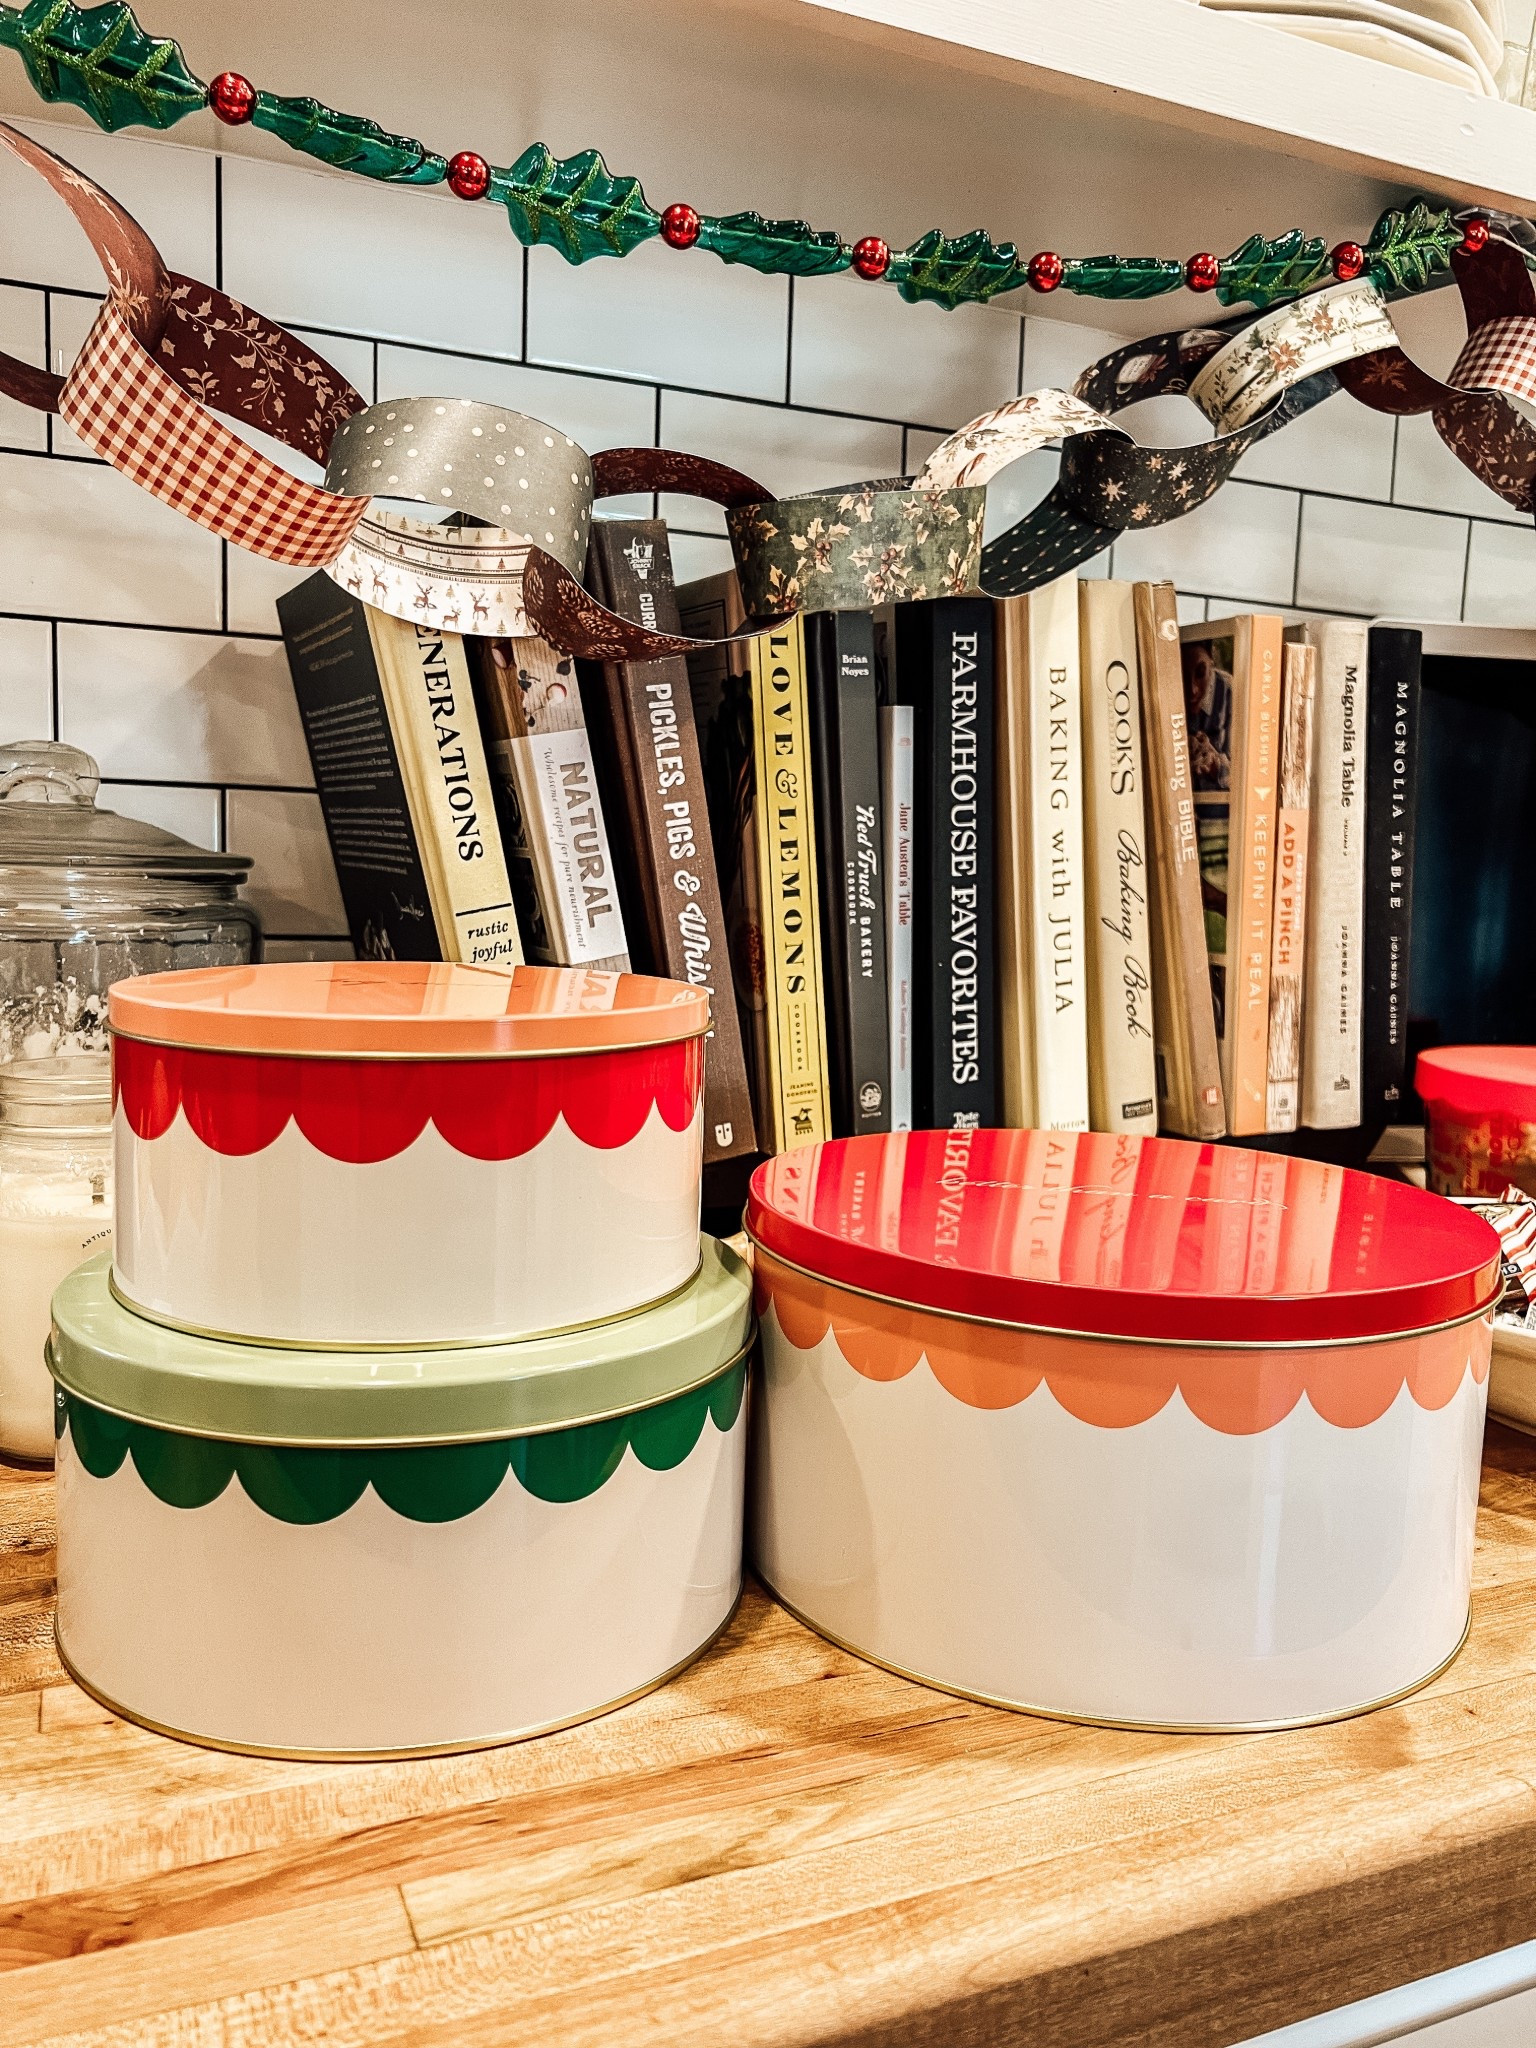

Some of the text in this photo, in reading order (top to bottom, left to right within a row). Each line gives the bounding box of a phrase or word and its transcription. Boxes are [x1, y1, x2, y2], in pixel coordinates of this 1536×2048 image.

[638, 593, 659, 633] CURR
[841, 655, 869, 665] Brian
[841, 666, 870, 677] Noyes
[415, 624, 484, 861] ENERATIONS
[646, 683, 686, 795] PICKLES,
[1169, 712, 1187, 792] Baking
[1178, 799, 1196, 862] BIBLE
[1341, 665, 1358, 808] Magnolia Table
[560, 761, 613, 929] NATURAL
[662, 800, 696, 860] PIGS
[769, 634, 807, 994] LOVE & LEMONS
[899, 803, 911, 832] Jane
[1048, 666, 1074, 1015] BAKING with JULIA
[1101, 660, 1152, 1040] COOK'S Baking Book
[1390, 681, 1409, 909] MAGNOLIA TABLE
[672, 869, 701, 897] &
[847, 862, 857, 925] COOKBOOK
[855, 804, 878, 978] Red Truck BAKERY
[898, 891, 911, 926] Table
[950, 631, 980, 1086] FARMHOUSE FAVORITES
[1249, 813, 1268, 1011] KEEPIN' IT REAL
[1278, 822, 1295, 964] ADD A PINCH
[468, 921, 508, 939] rustic
[470, 939, 513, 963] joyful
[1390, 935, 1401, 990] JOANNA
[82, 1229, 112, 1249] ANTIQU
